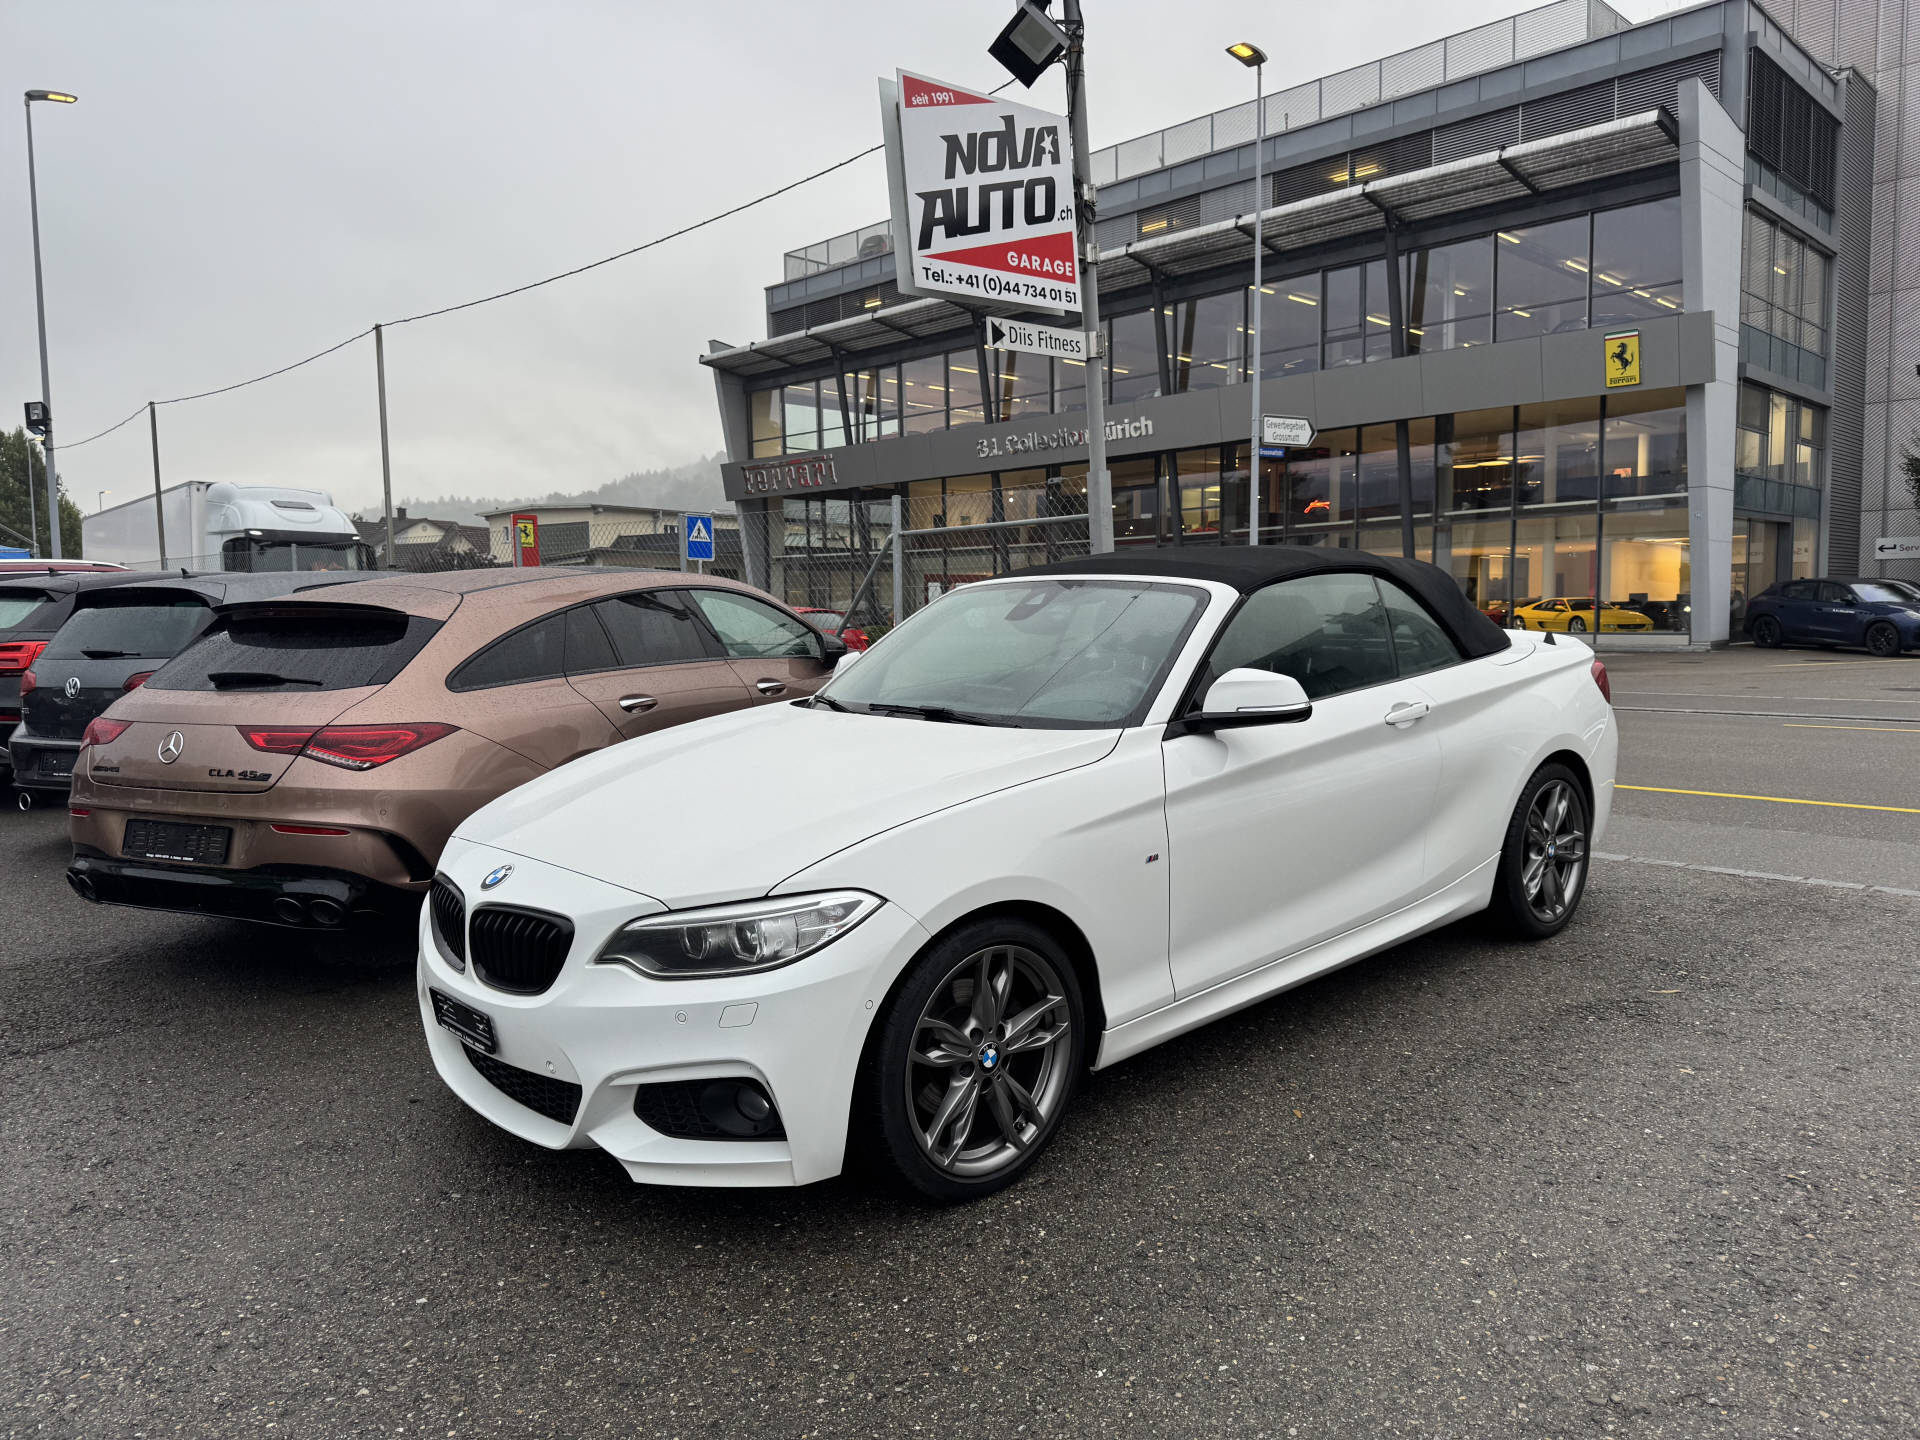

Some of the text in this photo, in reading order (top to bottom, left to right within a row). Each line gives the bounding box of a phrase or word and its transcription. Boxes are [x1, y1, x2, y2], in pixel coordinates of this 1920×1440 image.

[912, 91, 955, 106] seit 1991
[940, 114, 1061, 180] NOVA
[1007, 251, 1073, 277] GARAGE
[922, 266, 953, 284] Tel.:
[956, 273, 979, 290] +41
[1023, 283, 1047, 301] 734
[1050, 287, 1062, 302] 01
[1065, 290, 1077, 305] 51
[1009, 326, 1081, 354] Diis Fitness
[1104, 416, 1153, 441] ürich
[744, 453, 838, 494] Ferrari
[208, 768, 235, 778] CLA
